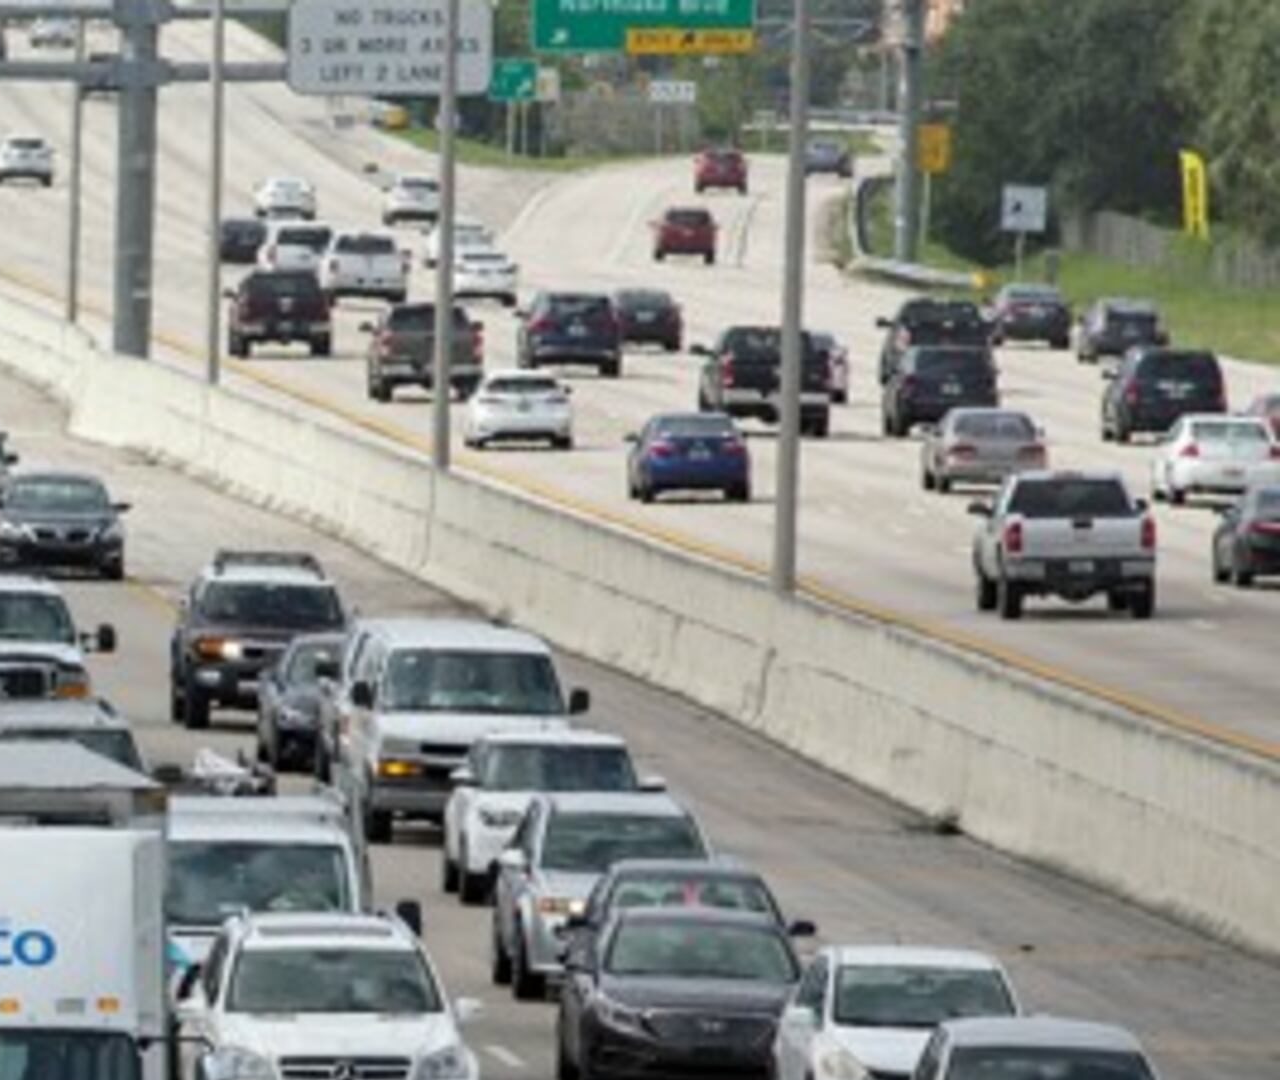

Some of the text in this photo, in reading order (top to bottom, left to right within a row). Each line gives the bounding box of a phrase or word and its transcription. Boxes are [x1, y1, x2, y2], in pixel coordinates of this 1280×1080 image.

[335, 9, 445, 26] NO TRUCKS
[358, 37, 407, 53] MORE
[421, 37, 479, 53] AXES
[319, 64, 451, 81] LEFT 2 LANE
